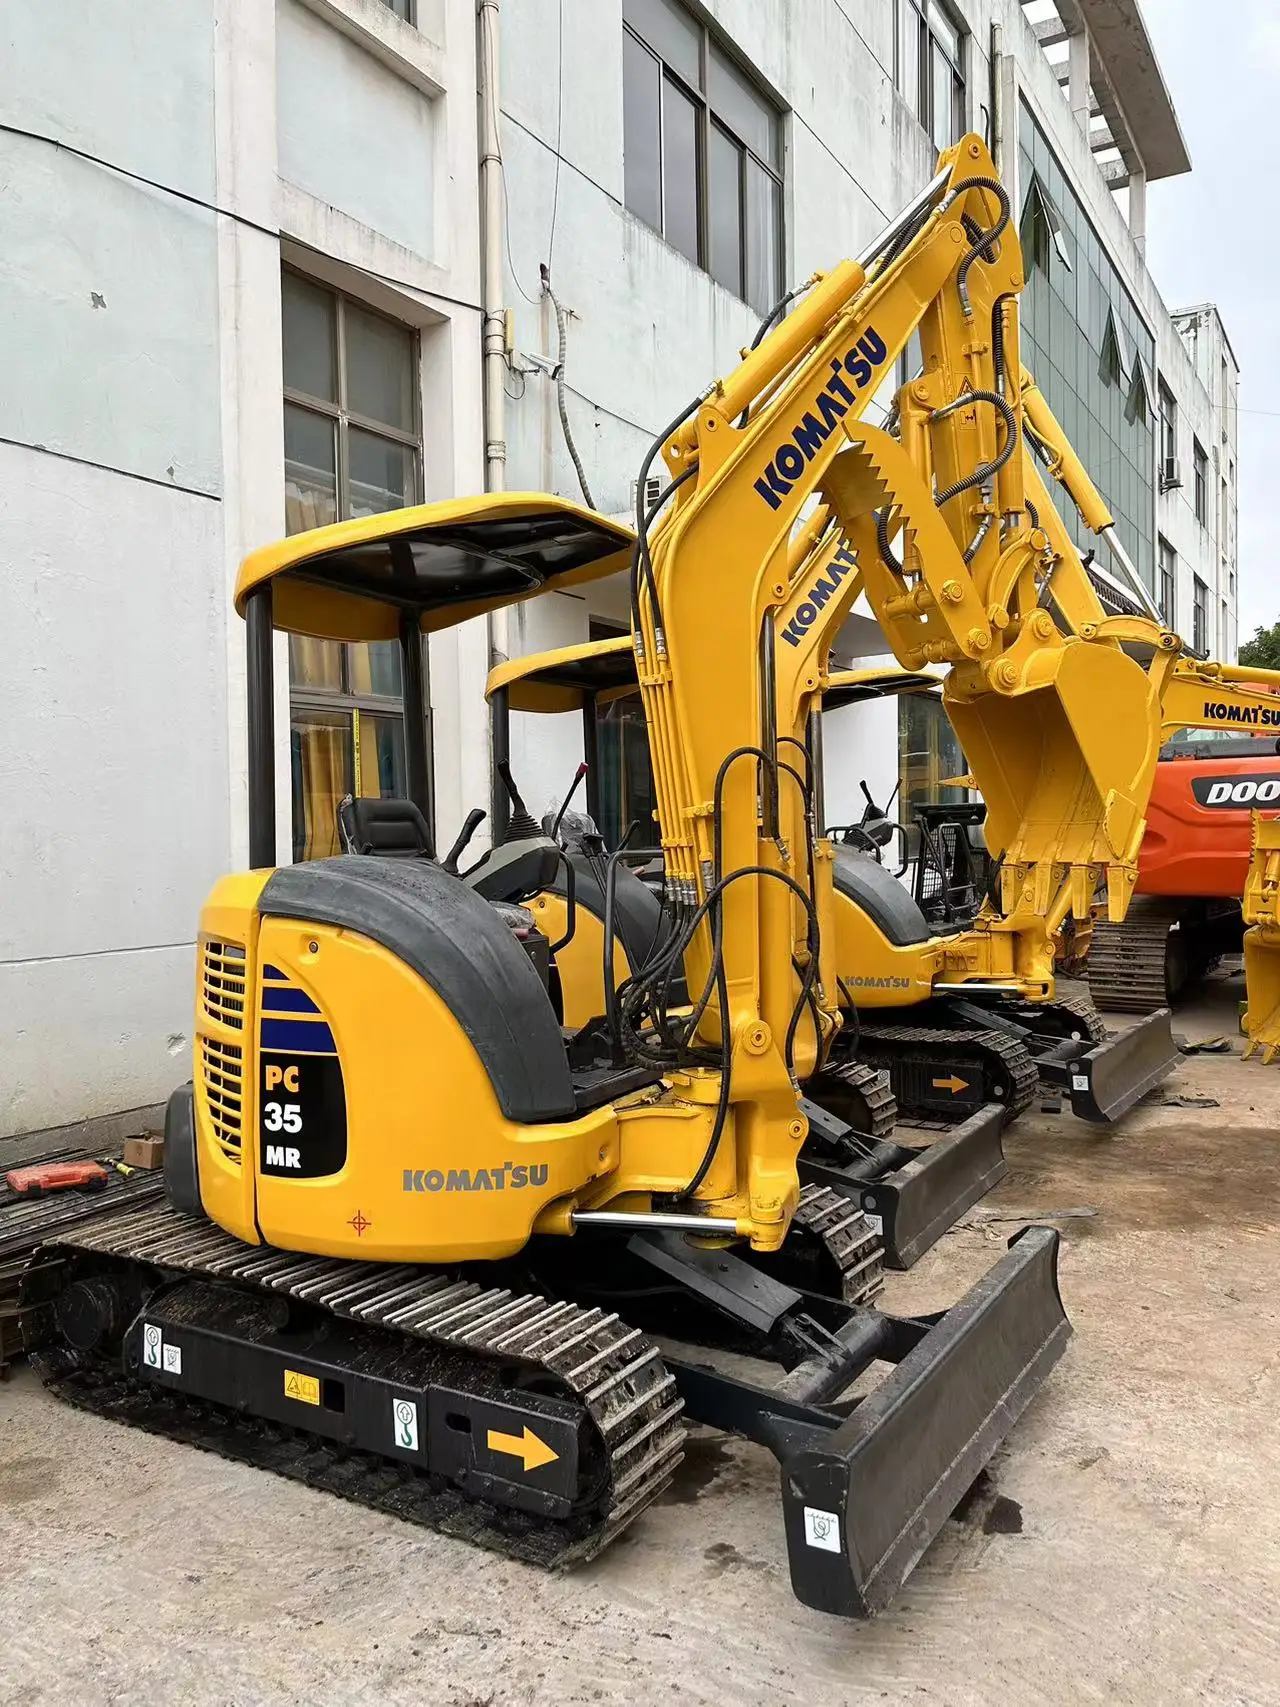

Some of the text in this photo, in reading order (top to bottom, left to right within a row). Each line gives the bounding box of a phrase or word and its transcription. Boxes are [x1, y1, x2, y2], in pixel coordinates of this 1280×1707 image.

[753, 325, 888, 511] KOMATSU
[780, 538, 858, 648] KOMAT
[265, 1064, 300, 1093] PC
[264, 1102, 303, 1134] 35
[266, 1144, 302, 1169] MR
[402, 1160, 549, 1192] KOMATSU
